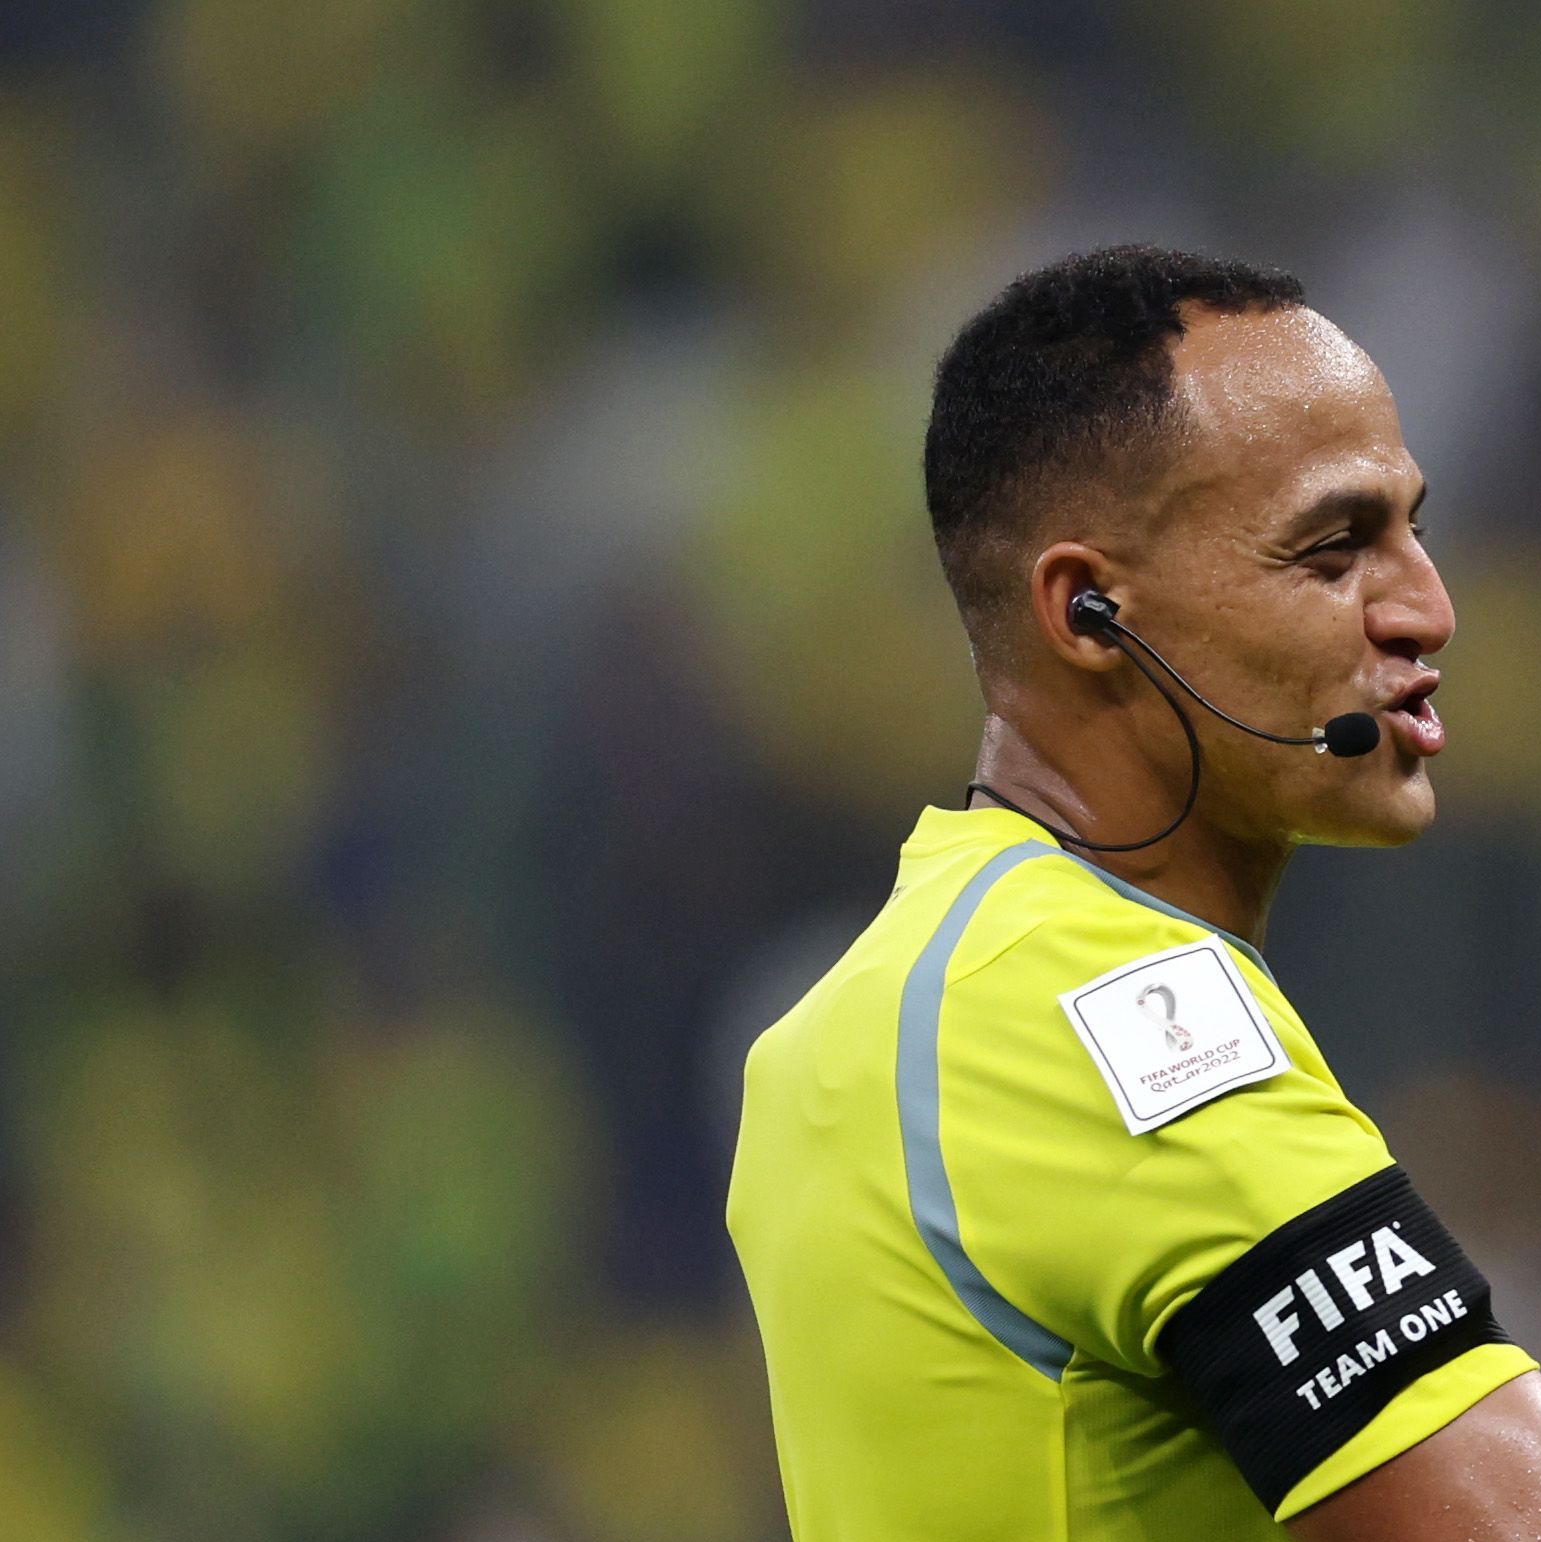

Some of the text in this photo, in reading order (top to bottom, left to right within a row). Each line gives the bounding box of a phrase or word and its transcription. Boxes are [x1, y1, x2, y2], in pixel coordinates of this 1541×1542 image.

[1139, 1039, 1240, 1085] FIFA WORLD CUP
[1252, 1225, 1436, 1367] FIFA
[1296, 1289, 1468, 1411] TEAM ONE
